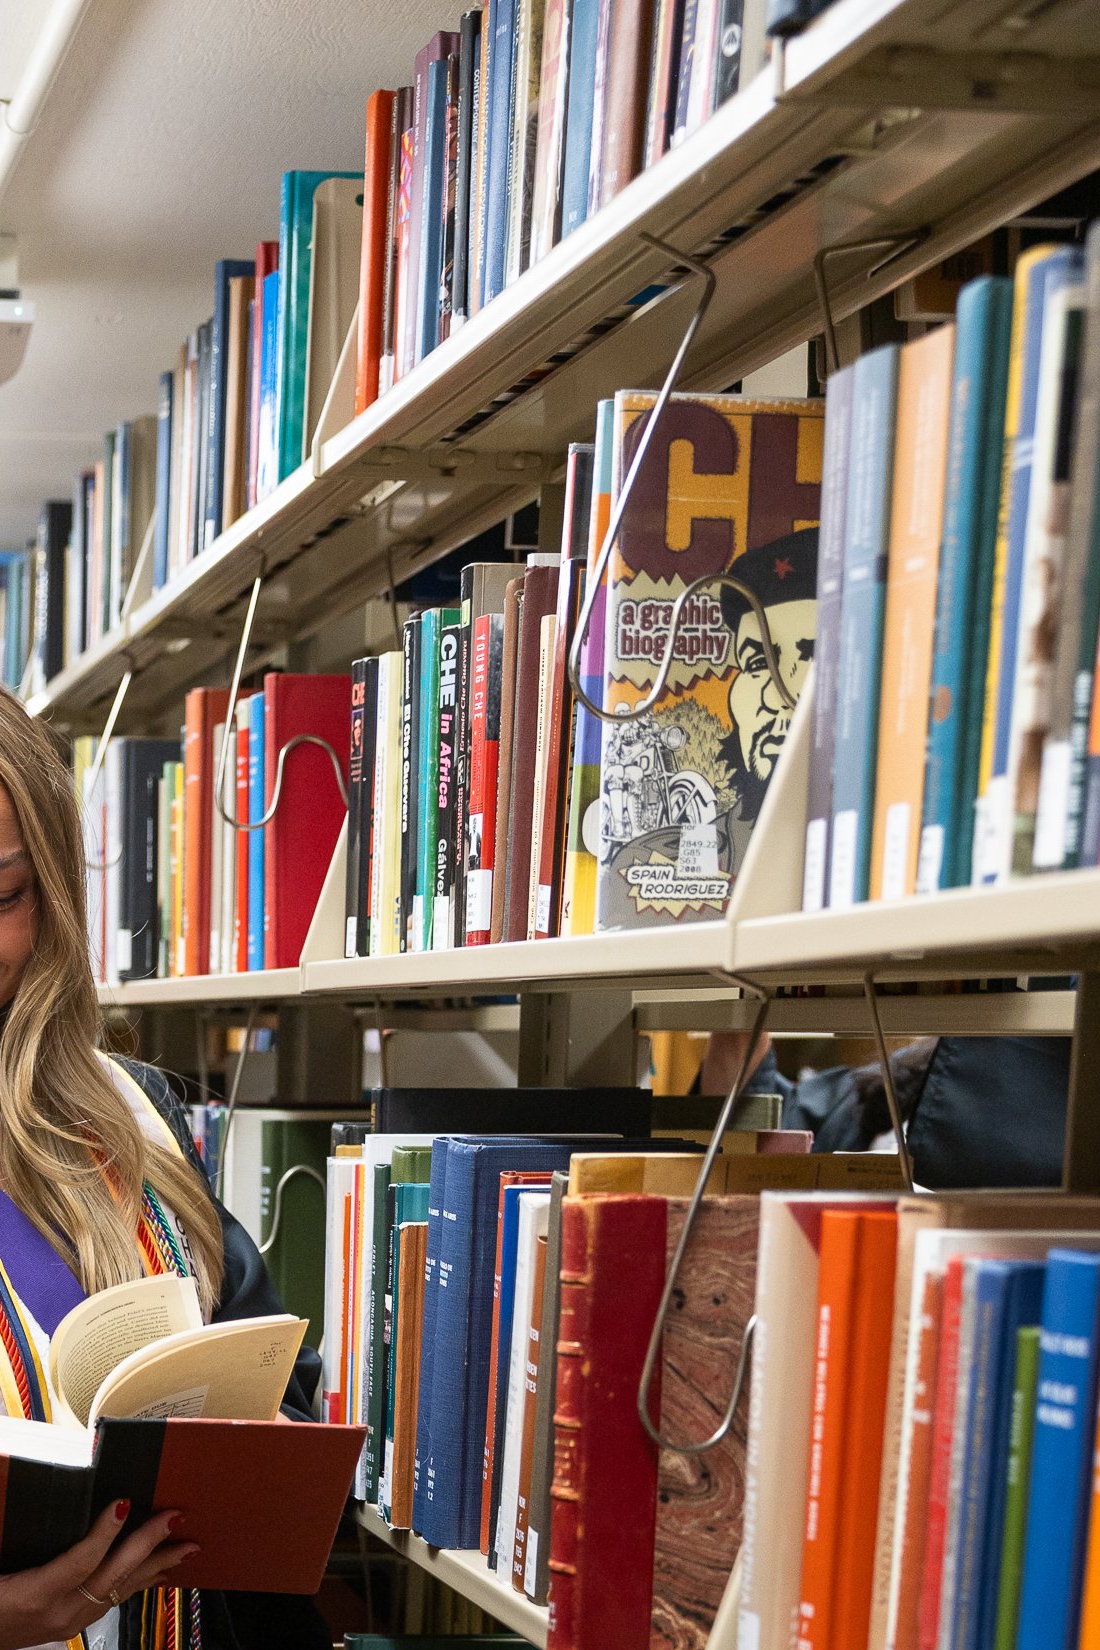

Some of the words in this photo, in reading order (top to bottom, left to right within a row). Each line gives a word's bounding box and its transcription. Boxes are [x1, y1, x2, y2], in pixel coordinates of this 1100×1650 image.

[472, 69, 480, 143] CONTEMPORARY
[621, 606, 635, 627] a
[475, 633, 486, 684] YOUNG
[621, 630, 727, 663] biogaphy
[440, 634, 457, 709] CHE
[404, 704, 411, 721] El
[474, 692, 483, 720] CHE
[441, 713, 452, 734] in
[403, 722, 411, 759] Che
[438, 745, 452, 809] Africa
[402, 760, 410, 833] Guevara
[631, 869, 671, 881] SPAIN
[644, 884, 725, 895] RODRIGUEZ
